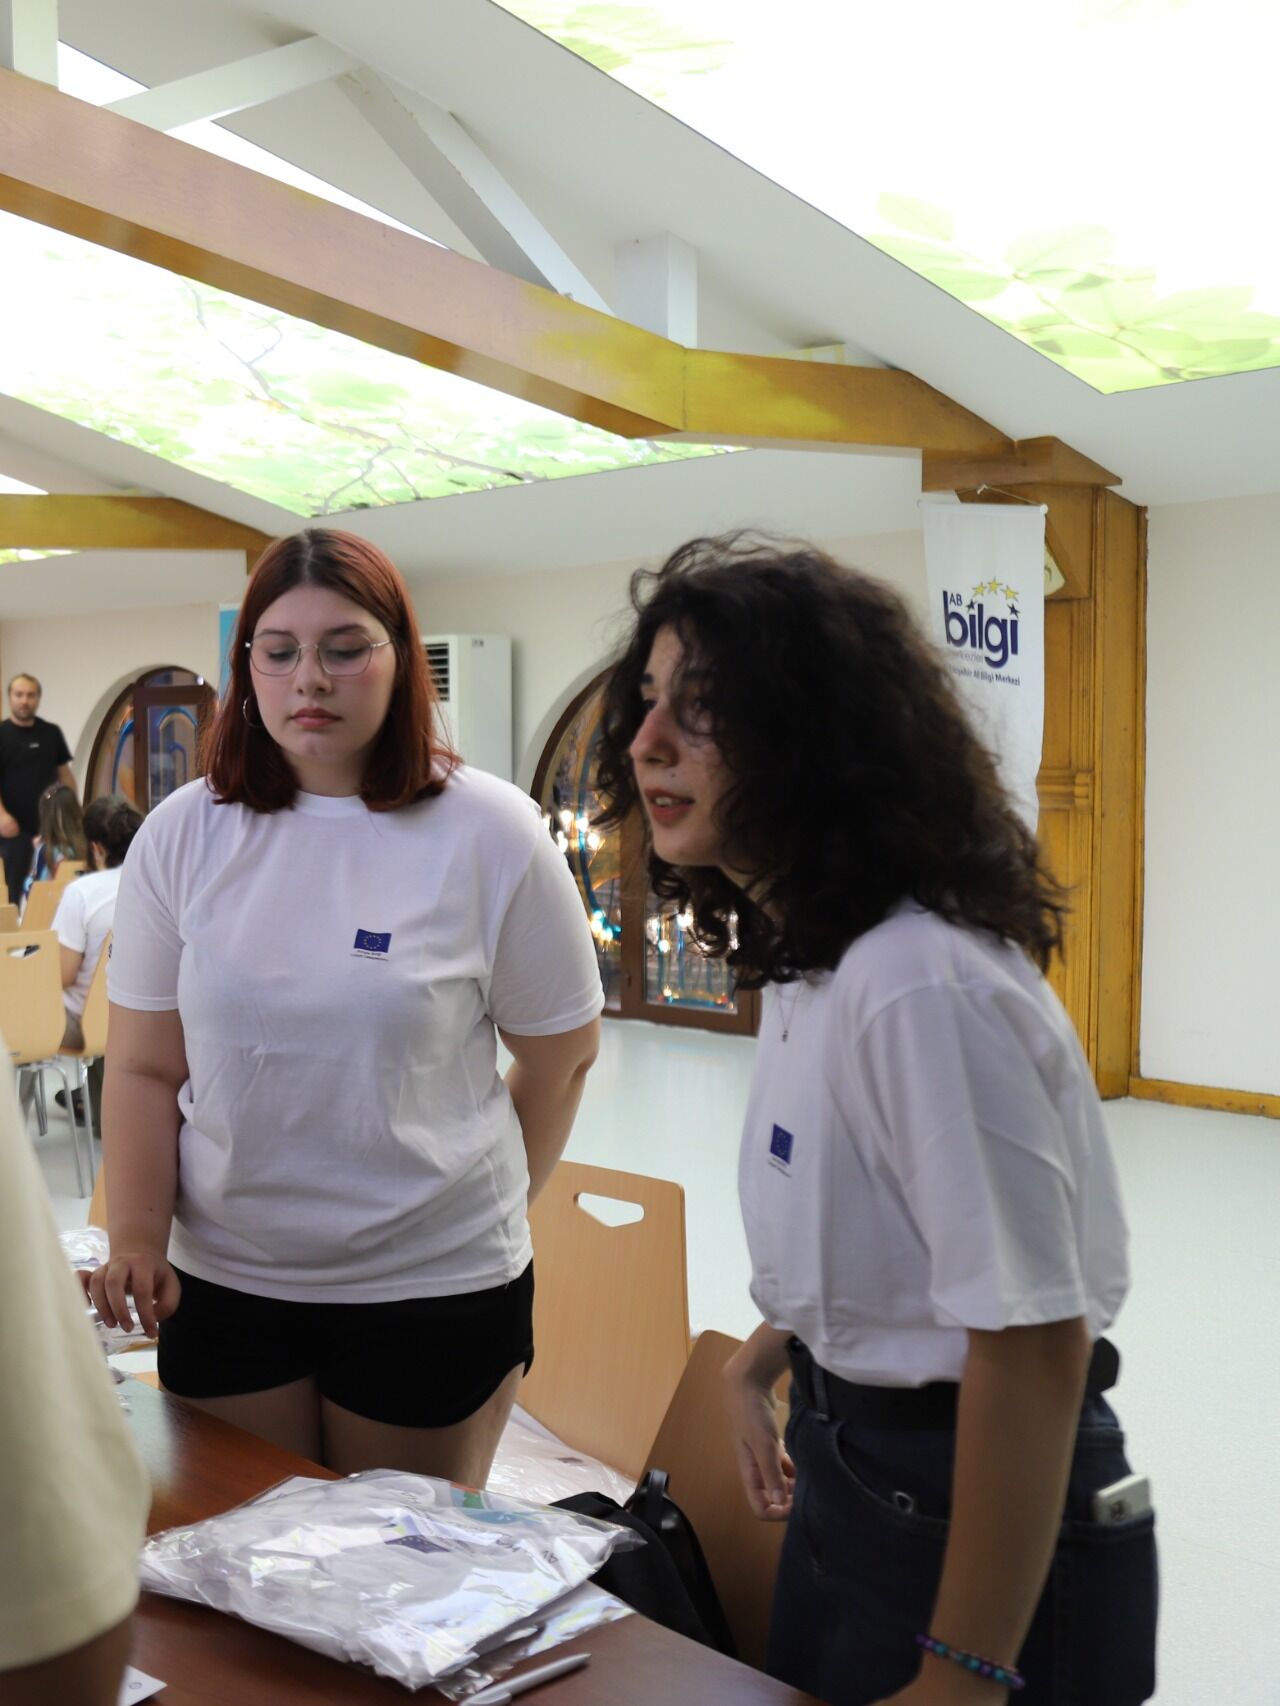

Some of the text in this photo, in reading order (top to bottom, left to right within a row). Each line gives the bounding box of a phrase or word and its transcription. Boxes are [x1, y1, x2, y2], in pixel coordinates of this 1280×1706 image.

[949, 593, 963, 606] AB
[942, 590, 1019, 669] bilgi
[995, 673, 1021, 686] Merkezi
